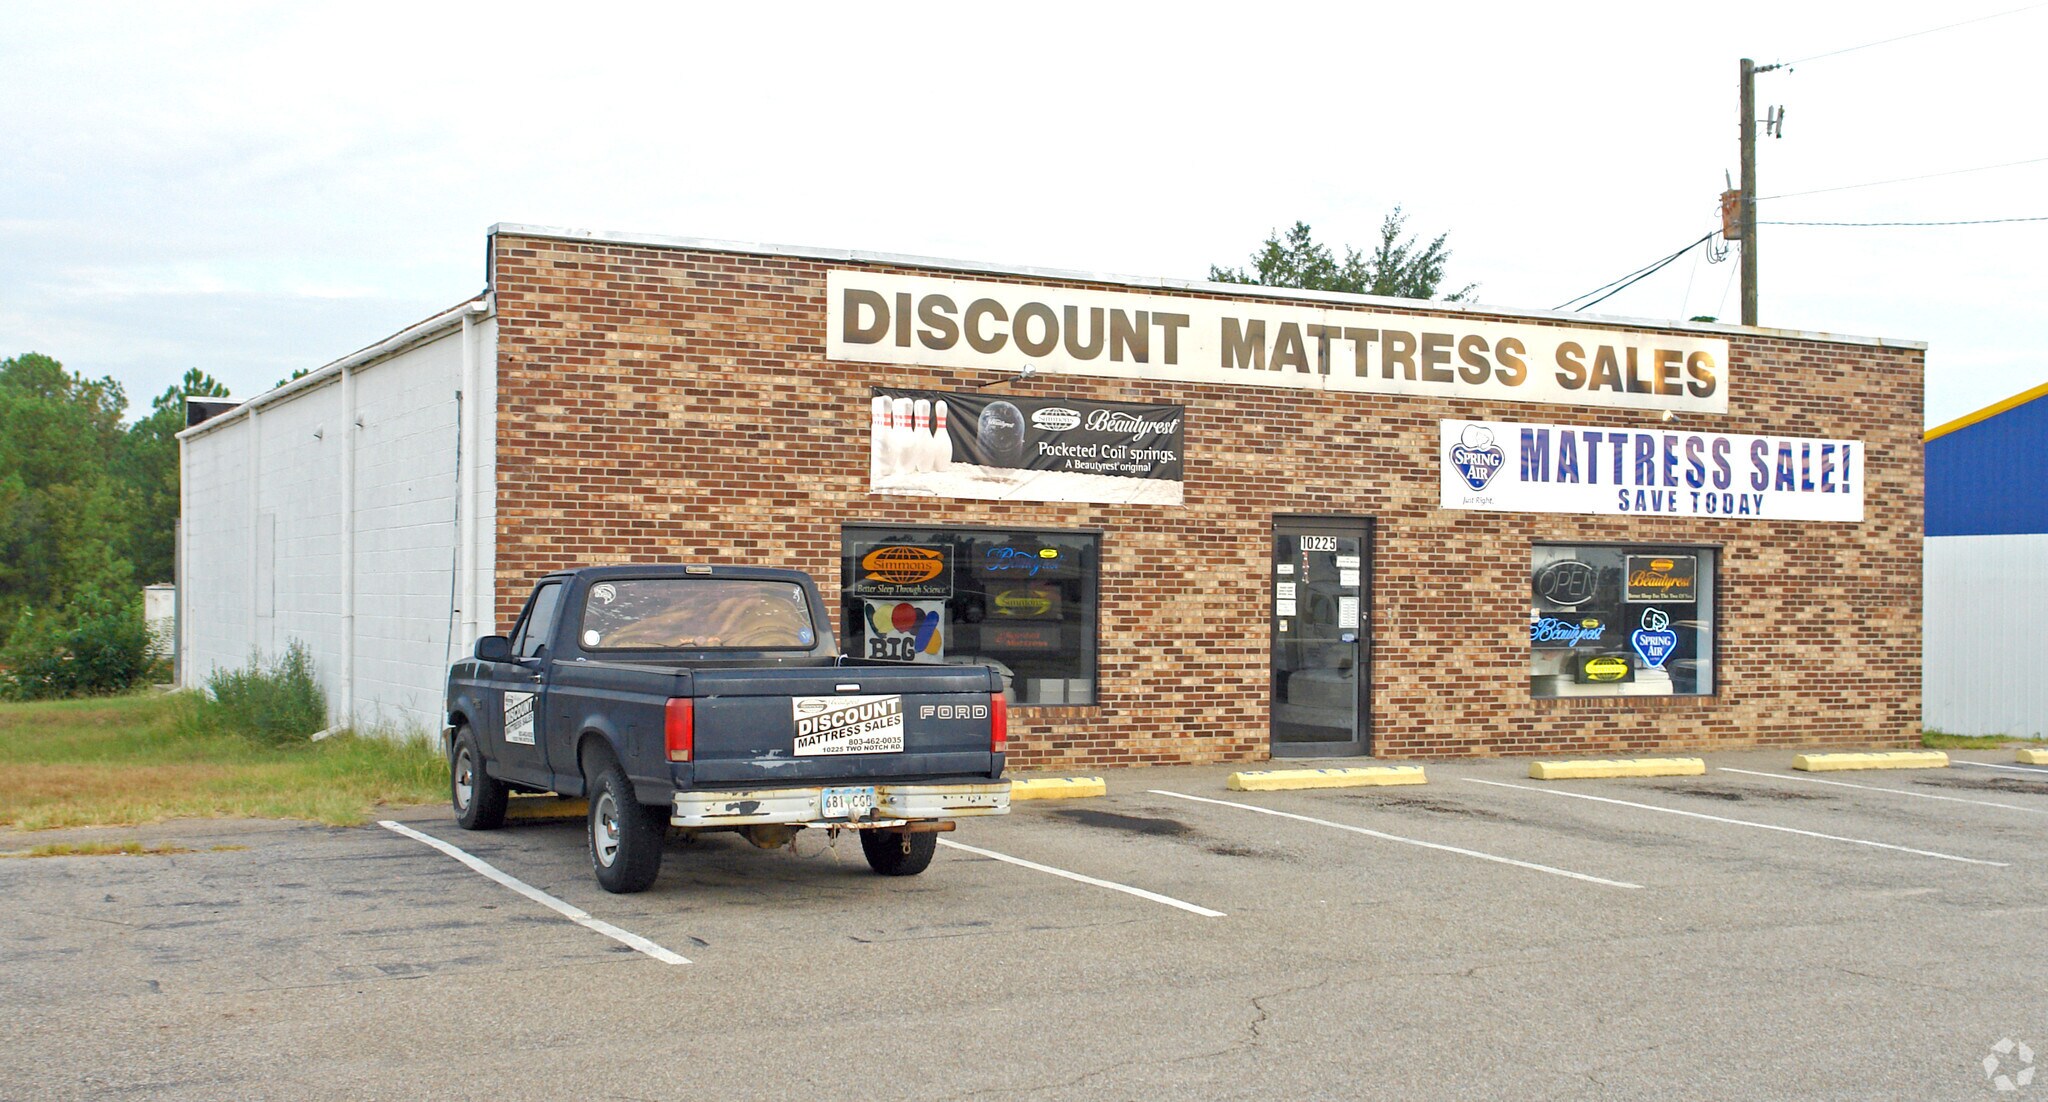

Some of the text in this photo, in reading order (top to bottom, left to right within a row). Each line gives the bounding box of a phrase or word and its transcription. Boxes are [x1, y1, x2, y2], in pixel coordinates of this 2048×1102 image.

[843, 288, 1717, 398] DISCOUNT MATTRESS SALES
[1085, 409, 1179, 442] Beautyrest
[1038, 441, 1097, 458] Pocketed
[1130, 447, 1177, 464] springs.
[1454, 449, 1500, 467] SPRING
[1520, 428, 1851, 493] MATTRESS SALE!
[1065, 459, 1073, 469] A
[1120, 463, 1151, 474] original
[1466, 465, 1489, 480] AIR
[1618, 489, 1764, 515] SAVE TODAY
[1302, 536, 1336, 550] 10225
[873, 560, 932, 570] Simmons
[857, 584, 877, 593] Better
[877, 585, 894, 595] Sleep
[896, 585, 921, 595] Through
[1539, 570, 1599, 595] OPEN
[1628, 569, 1692, 593] Beautyrest
[1530, 617, 1606, 647] Beautyrest
[1640, 634, 1671, 646] SPRING
[869, 637, 915, 661] BIG
[1648, 645, 1663, 656] AIR
[798, 697, 900, 736] DISCOUNT
[920, 705, 988, 720] FORD
[798, 715, 901, 748] MATTRESS SALES
[848, 737, 902, 746] 803-462-0035
[826, 795, 843, 808] 681
